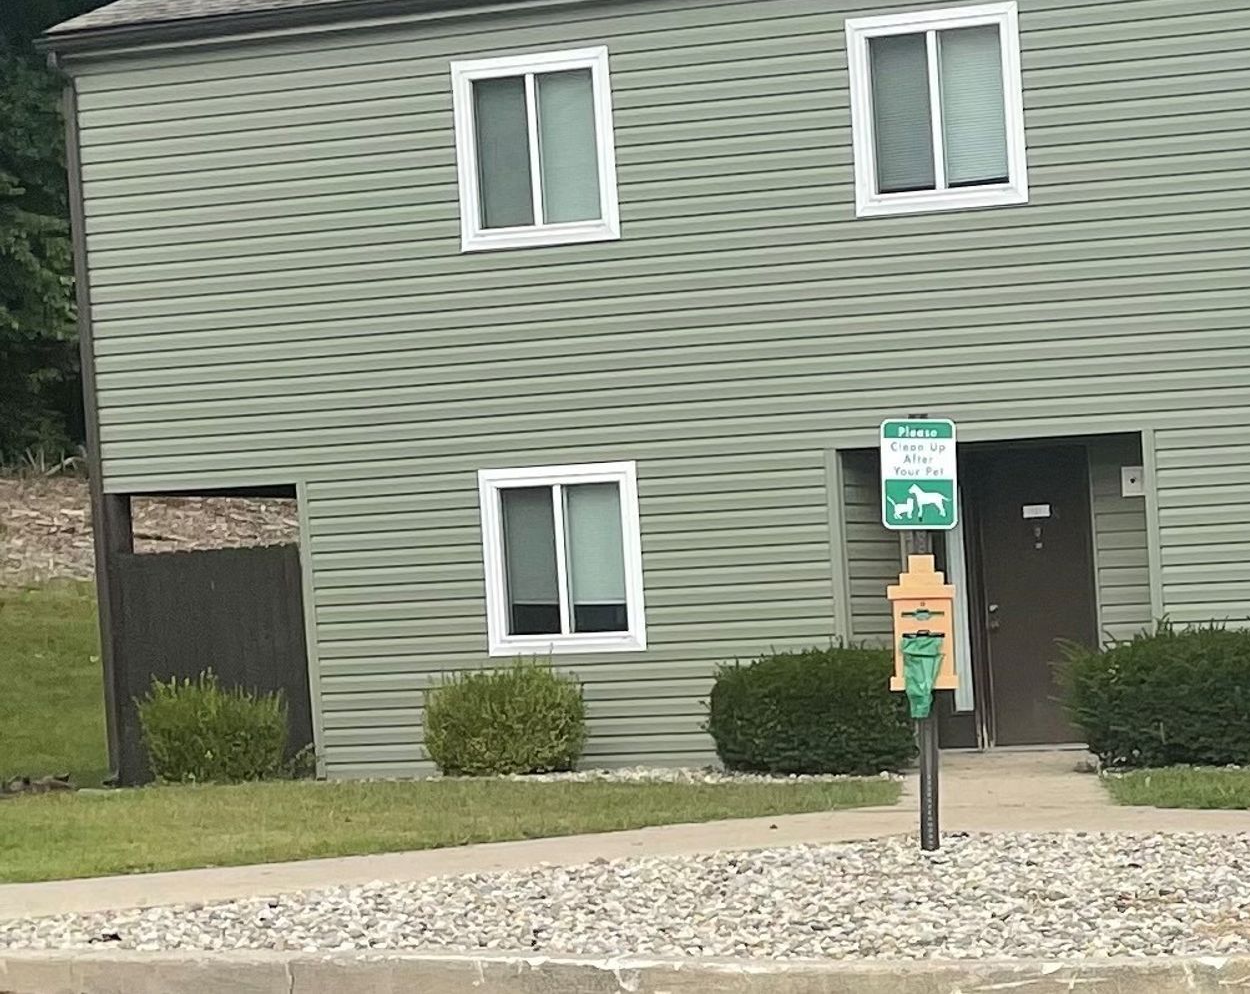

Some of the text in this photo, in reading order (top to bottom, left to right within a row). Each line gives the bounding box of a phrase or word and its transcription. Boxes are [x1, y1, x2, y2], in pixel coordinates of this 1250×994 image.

[898, 426, 937, 437] Please
[890, 442, 946, 453] Clean Up
[903, 454, 933, 464] After
[894, 466, 944, 476] Your Pet
